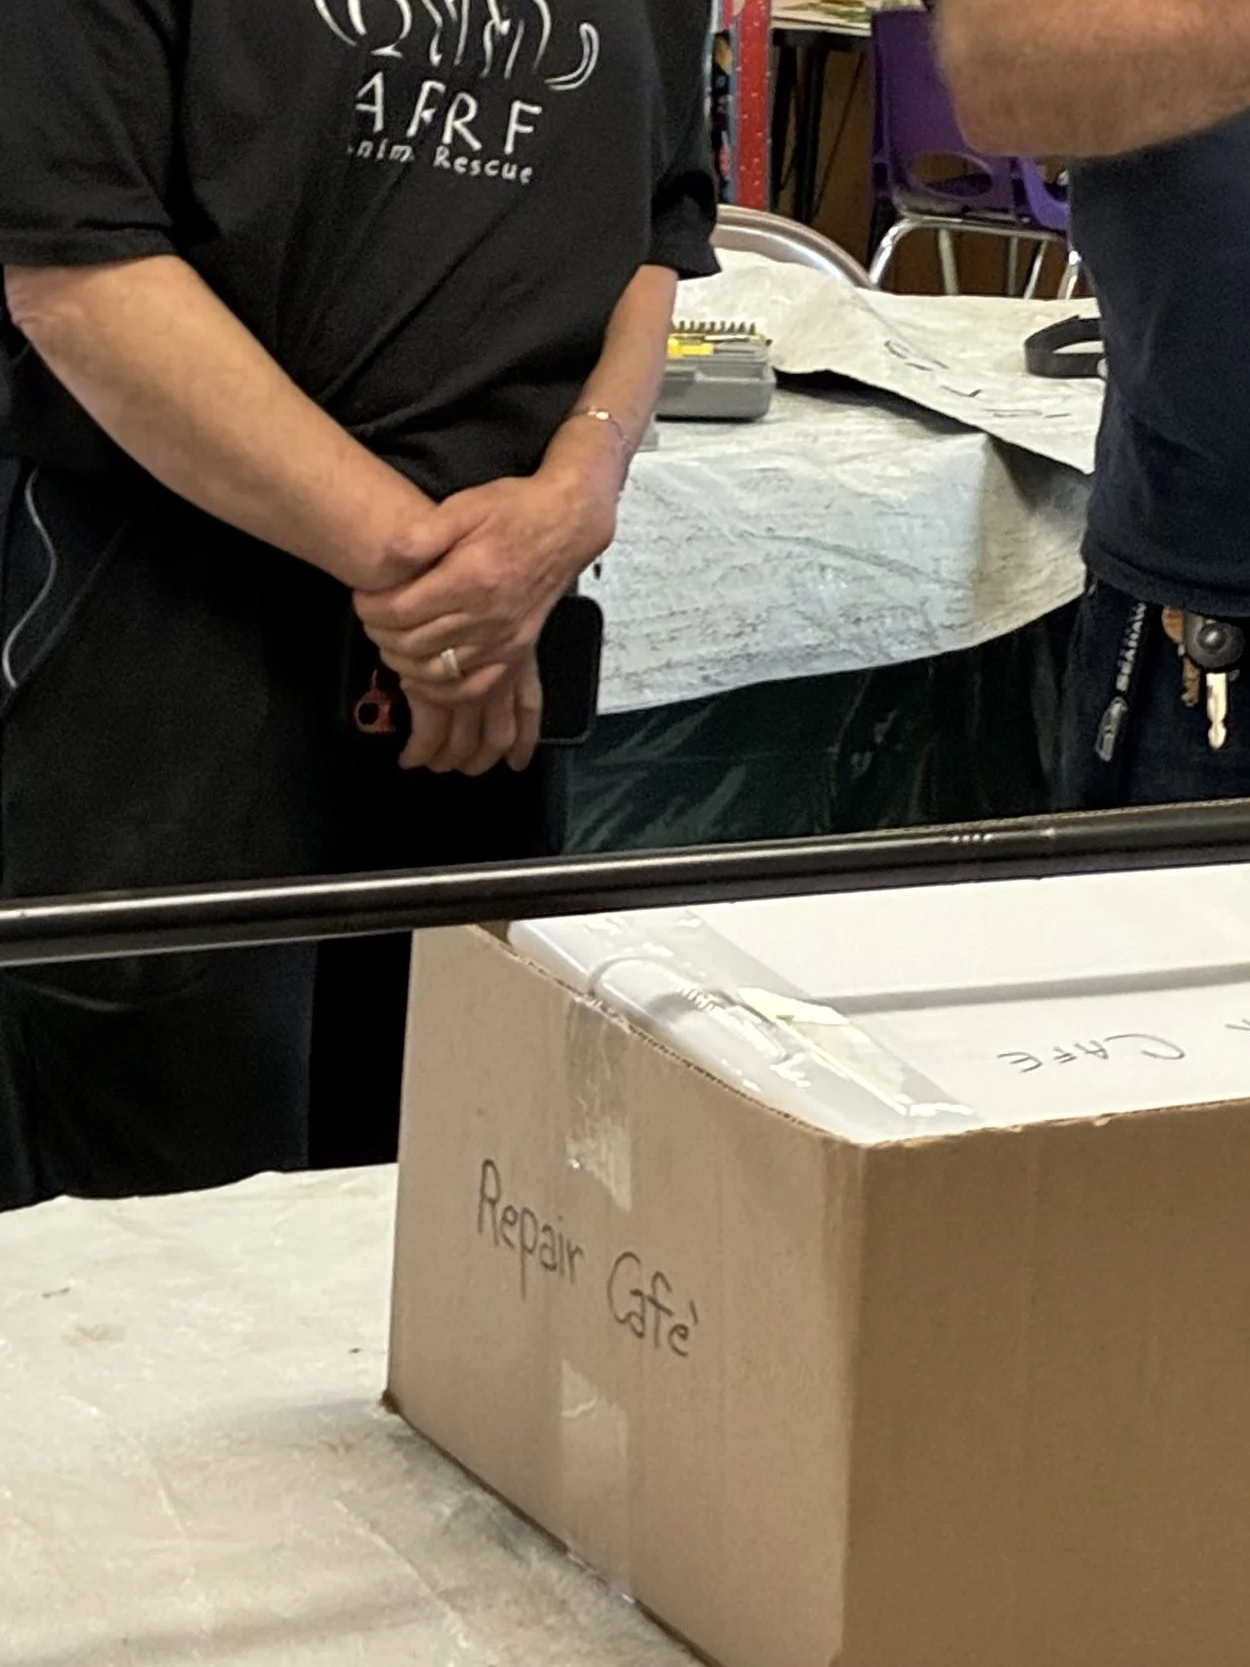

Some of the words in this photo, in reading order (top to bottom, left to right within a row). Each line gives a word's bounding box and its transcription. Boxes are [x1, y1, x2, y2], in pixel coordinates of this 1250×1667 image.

[434, 145, 533, 184] Rescue
[998, 1033, 1186, 1073] CAFE
[477, 1159, 585, 1301] Repair
